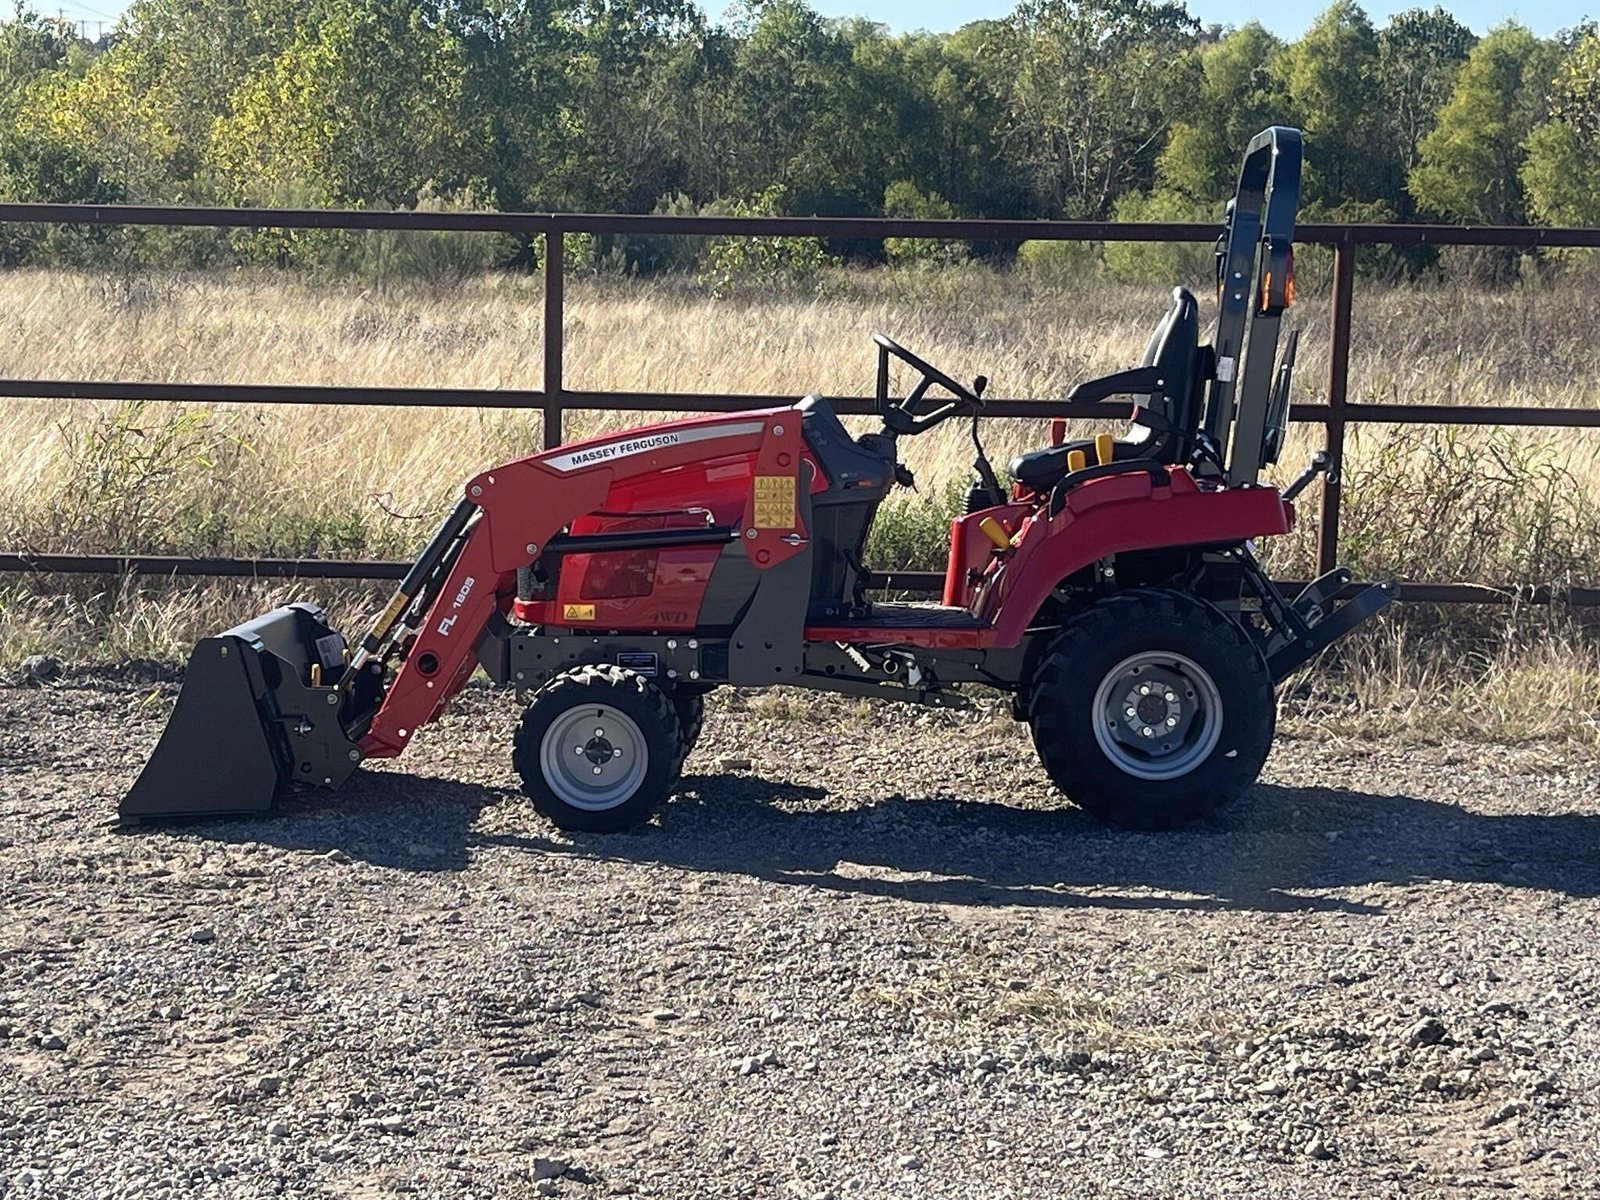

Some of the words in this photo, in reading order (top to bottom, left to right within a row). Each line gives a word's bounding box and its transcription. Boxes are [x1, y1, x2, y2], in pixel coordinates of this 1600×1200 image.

[571, 446, 616, 465] MASSEY
[620, 434, 679, 454] FERGUSON
[437, 614, 458, 636] FL
[453, 576, 475, 609] 1805
